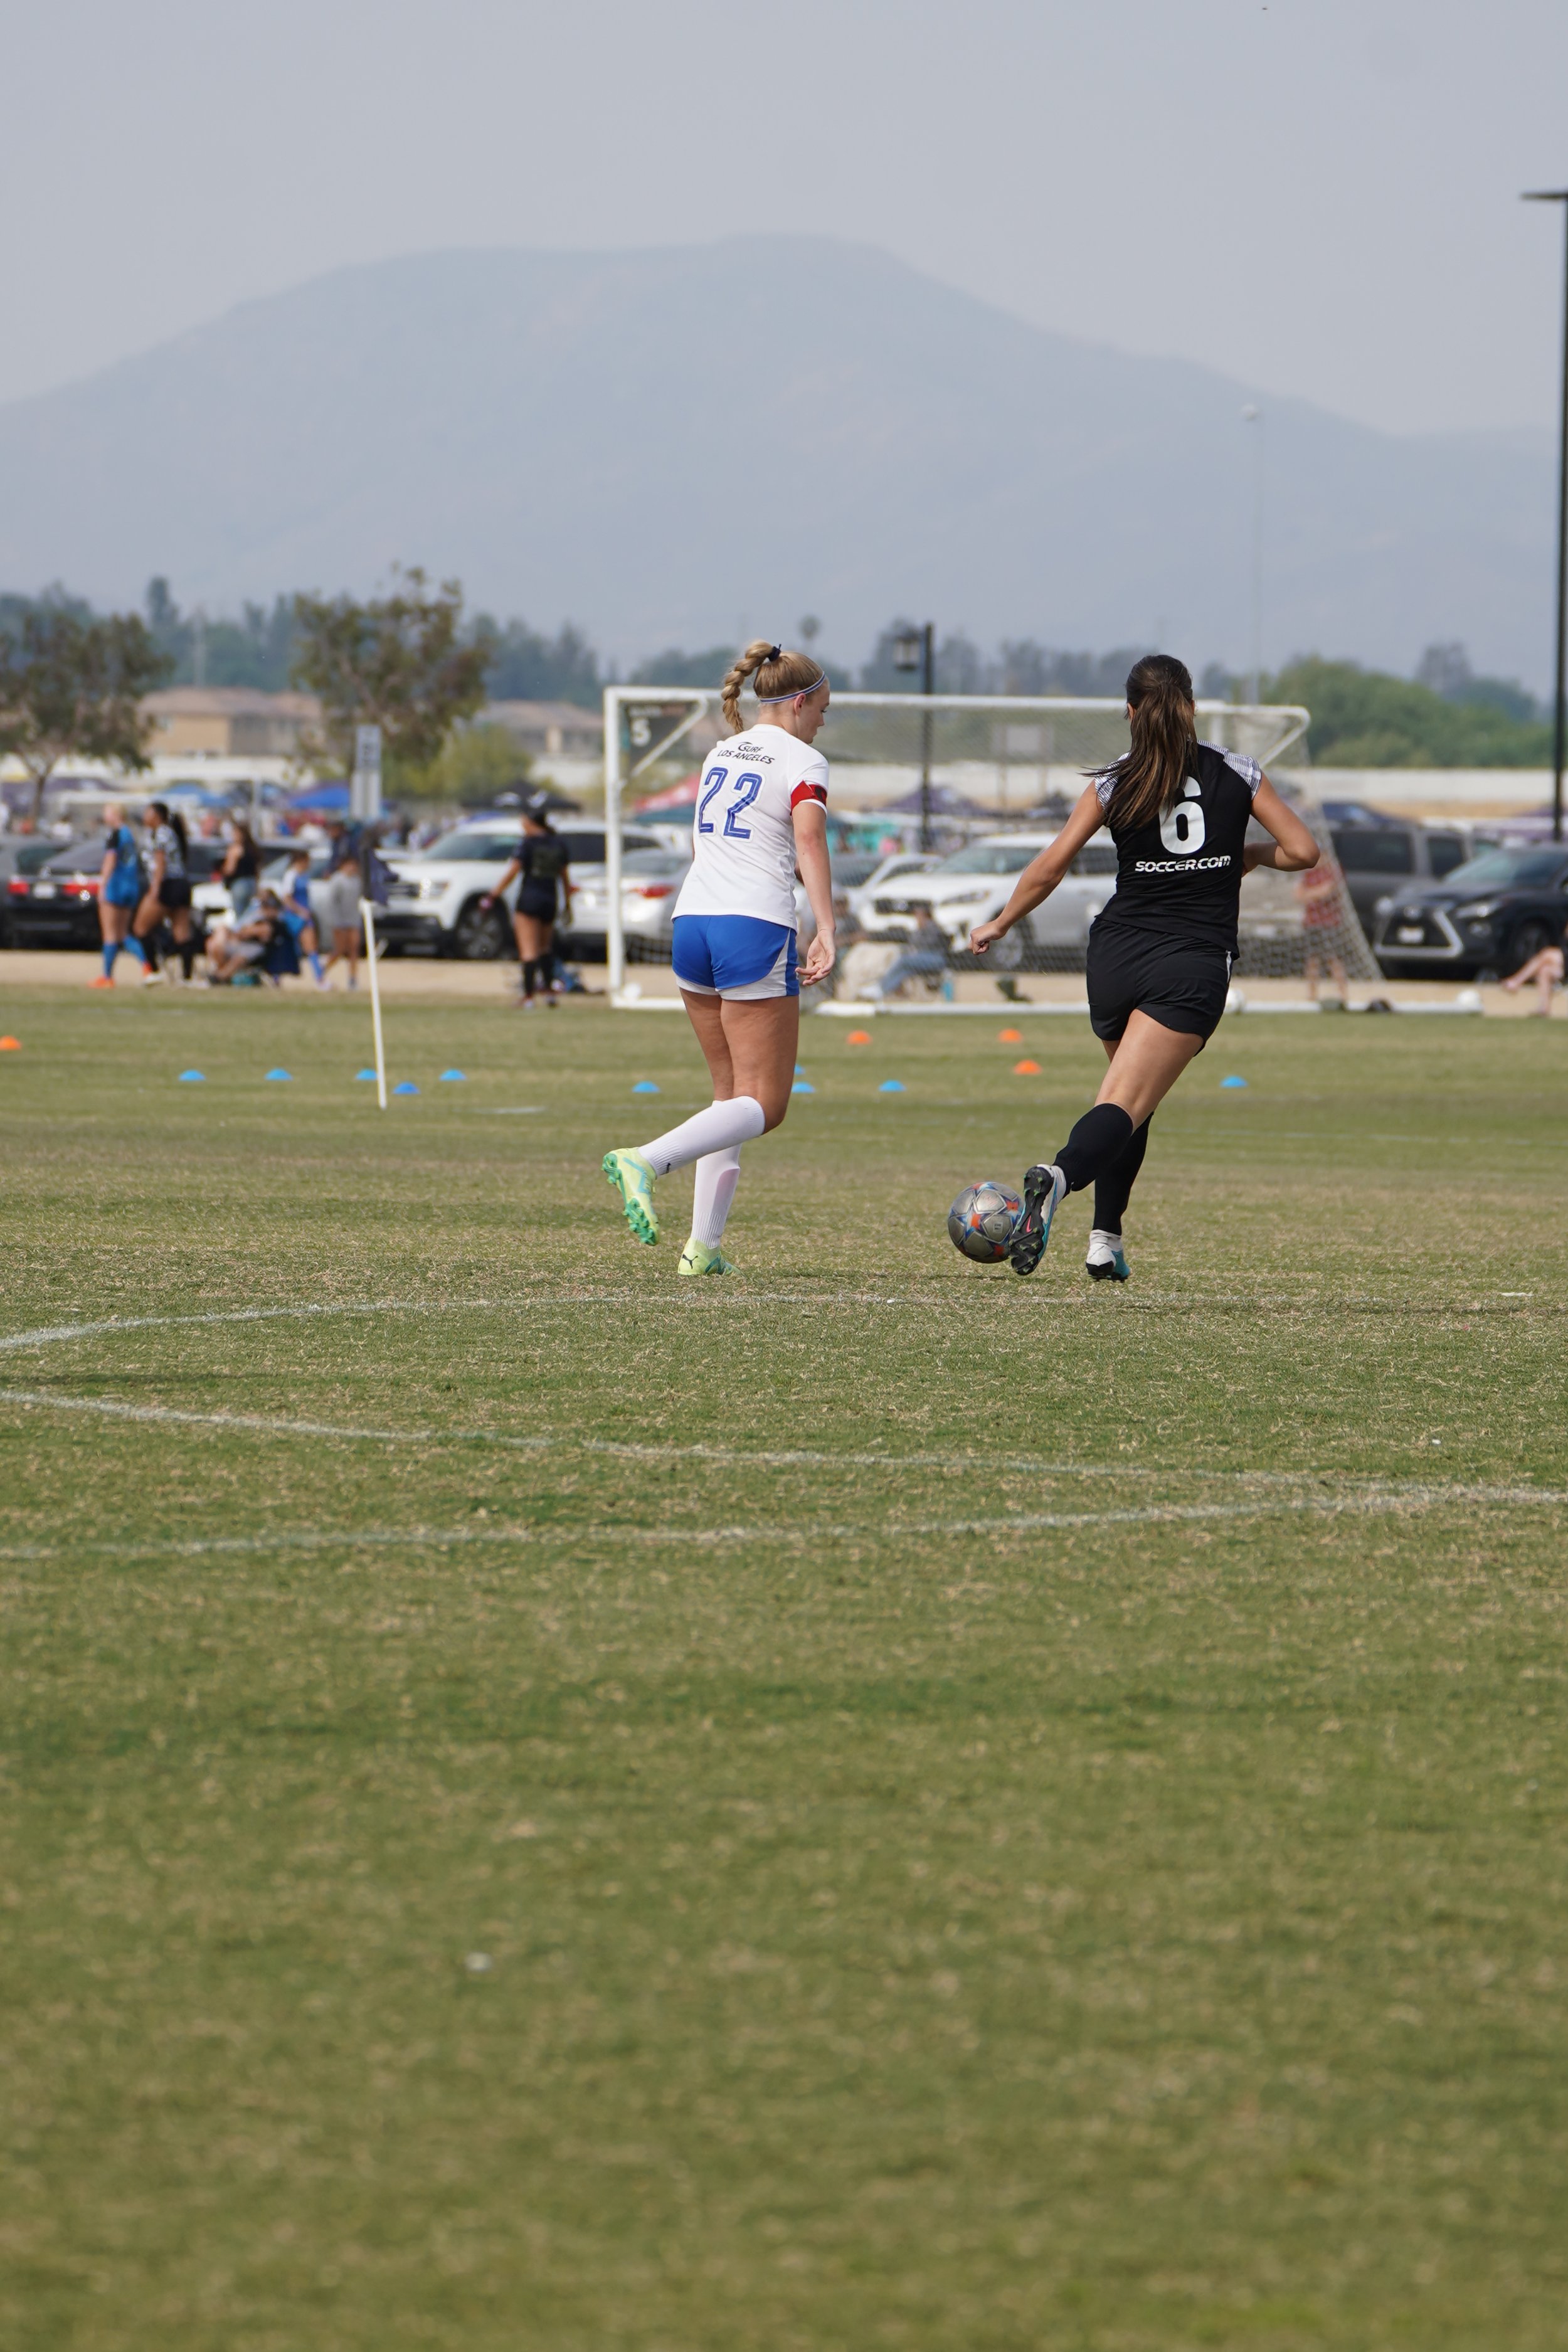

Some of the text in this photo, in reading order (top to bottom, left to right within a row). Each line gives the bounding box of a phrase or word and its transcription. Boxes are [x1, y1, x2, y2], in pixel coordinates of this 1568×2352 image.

[732, 752, 775, 764] ANGELES
[698, 766, 763, 839] 22
[1160, 776, 1205, 854] 6
[1135, 855, 1231, 872] SOCCER.COM
